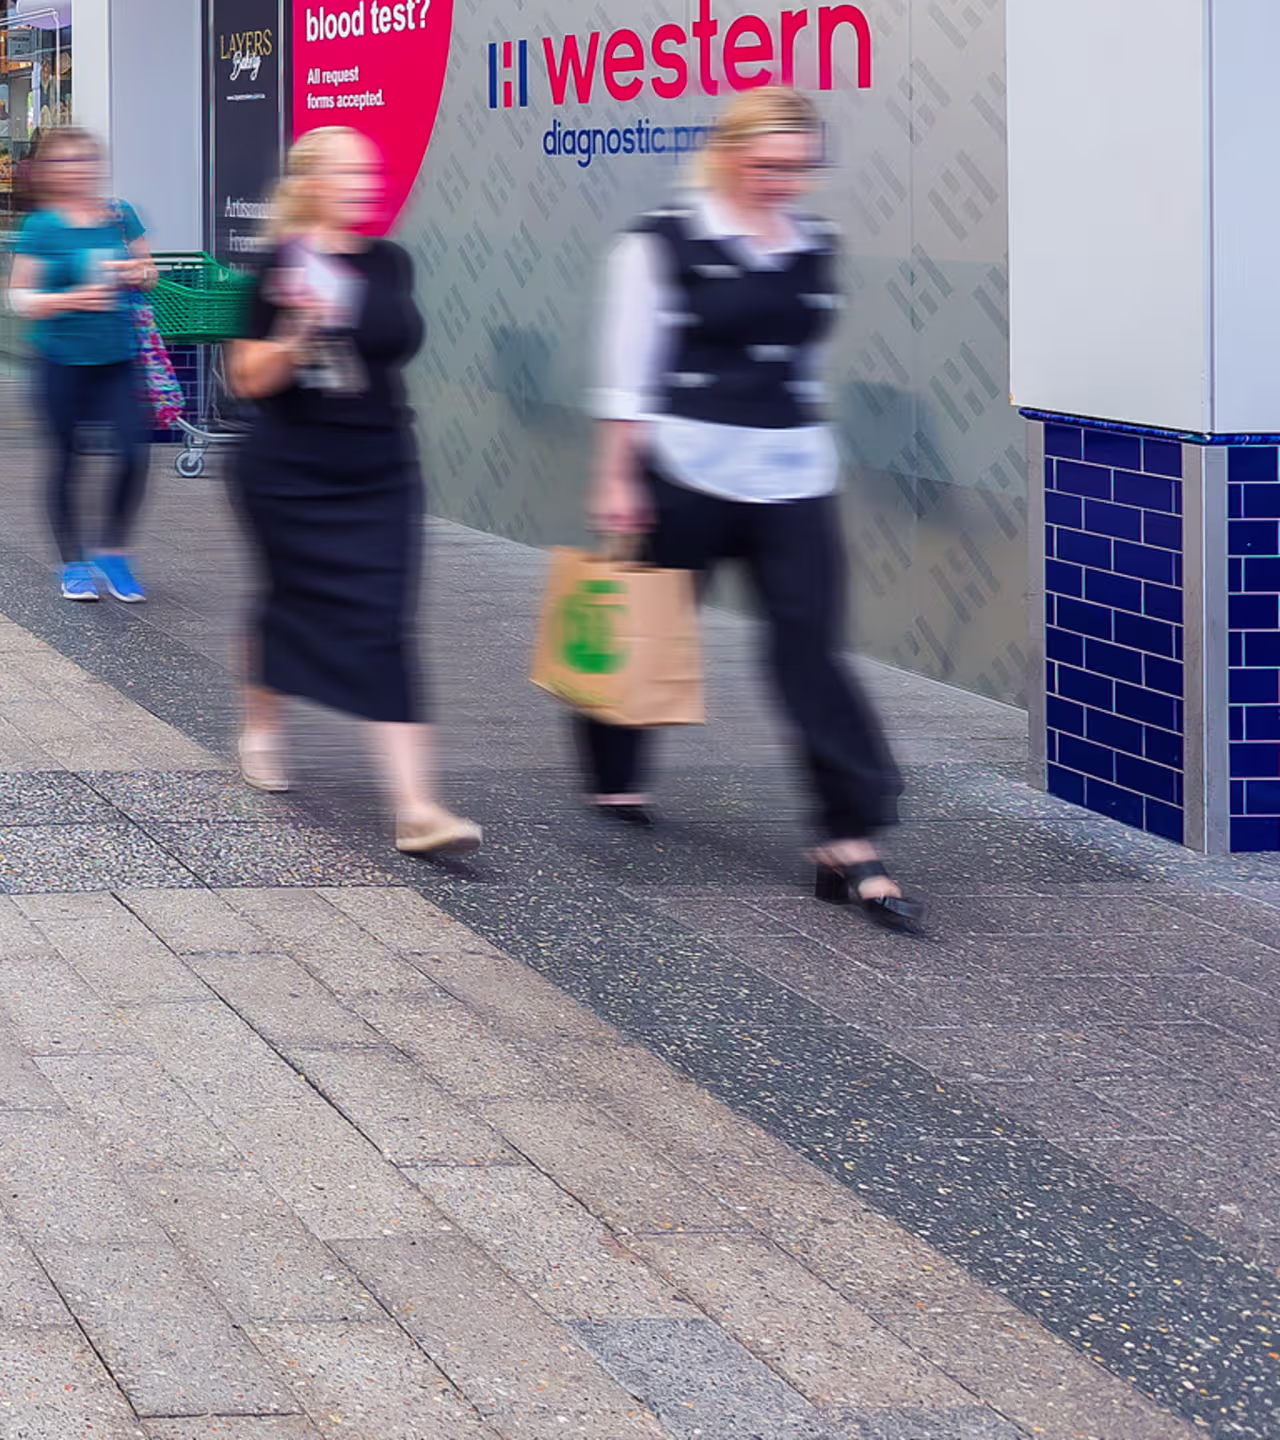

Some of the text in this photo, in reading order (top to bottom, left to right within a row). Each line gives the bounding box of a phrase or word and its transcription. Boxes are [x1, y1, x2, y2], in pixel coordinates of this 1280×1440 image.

[305, 1, 365, 42] blood
[219, 29, 273, 60] LAYERS
[307, 65, 360, 85] All request
[306, 88, 386, 111] forms accepted.
[542, 118, 666, 168] diagnostic
